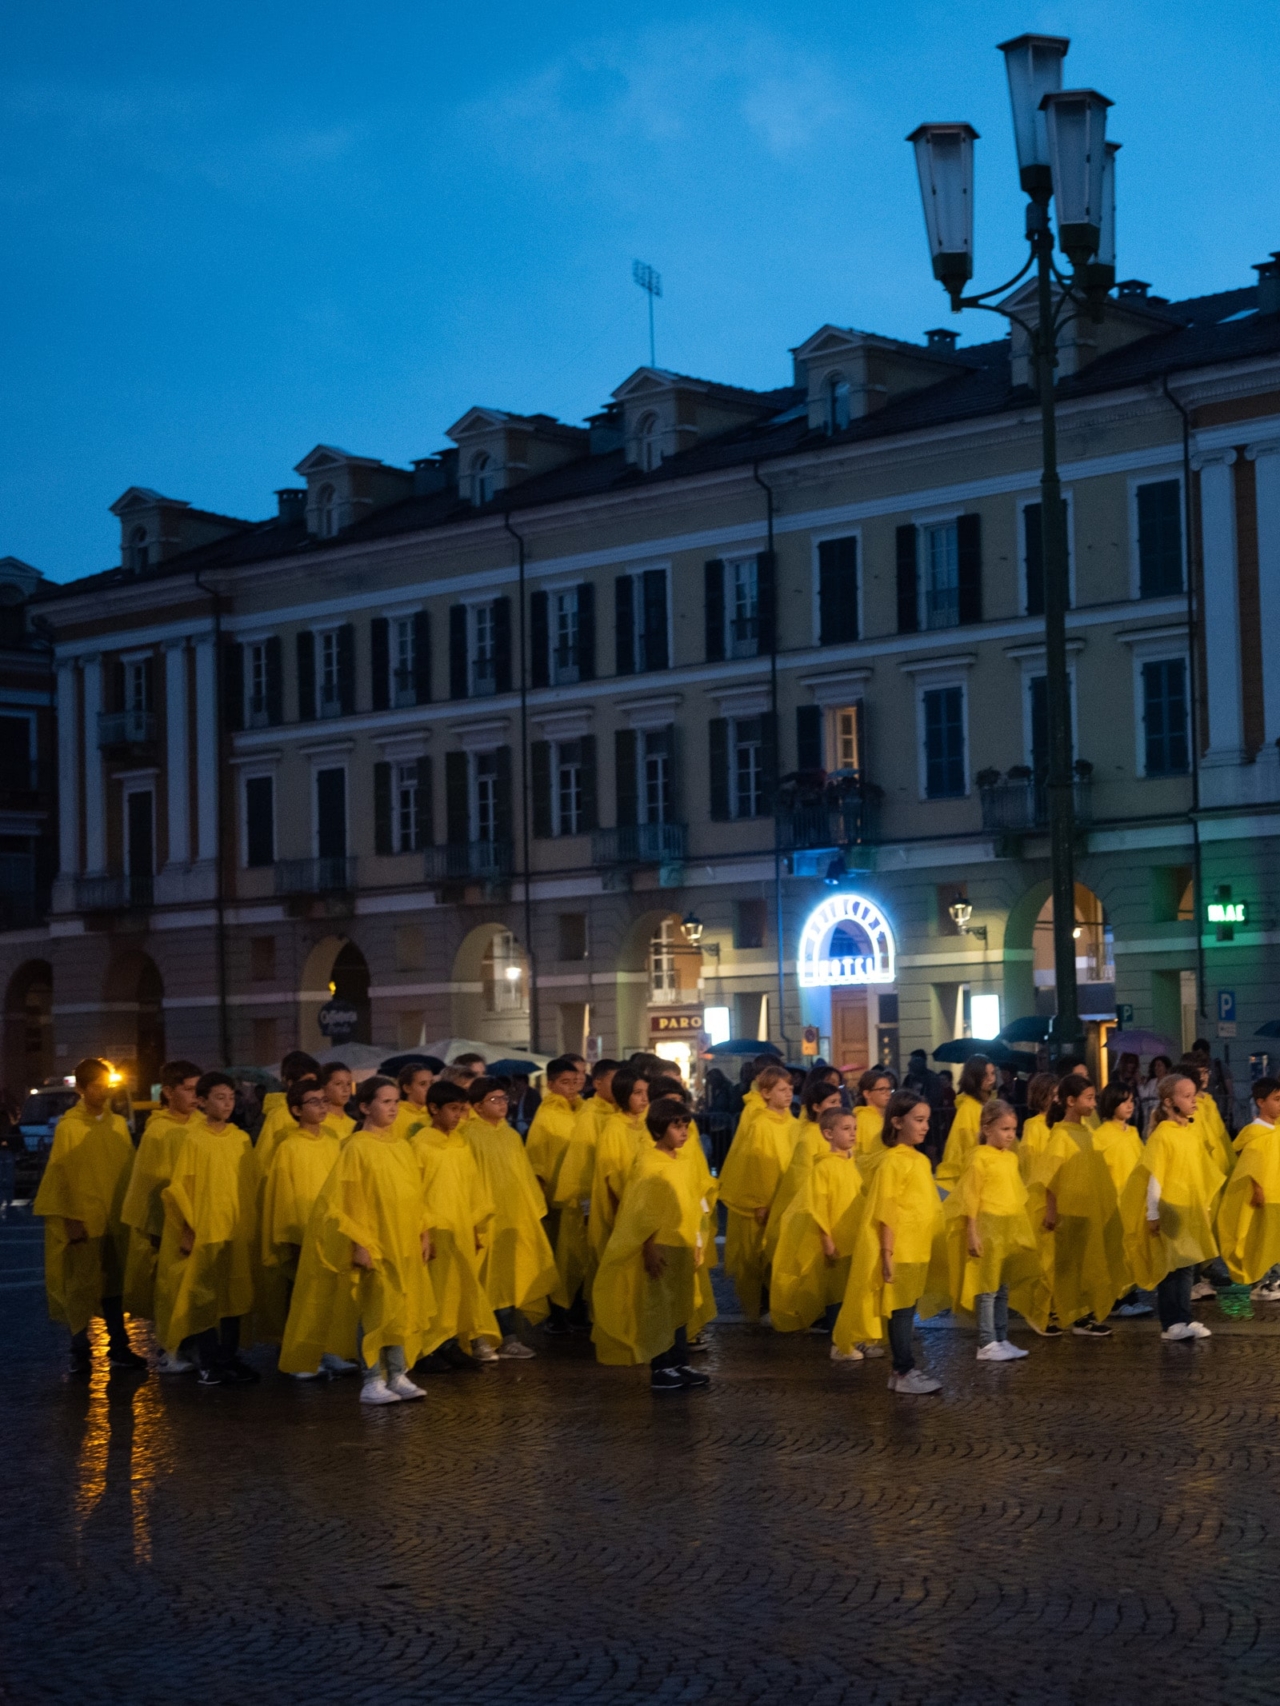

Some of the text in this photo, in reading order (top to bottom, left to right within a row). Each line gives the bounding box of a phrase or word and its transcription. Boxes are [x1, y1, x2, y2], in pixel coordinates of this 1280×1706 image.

[1123, 1005, 1132, 1020] P
[1220, 993, 1233, 1019] P
[659, 1016, 702, 1029] PARO
